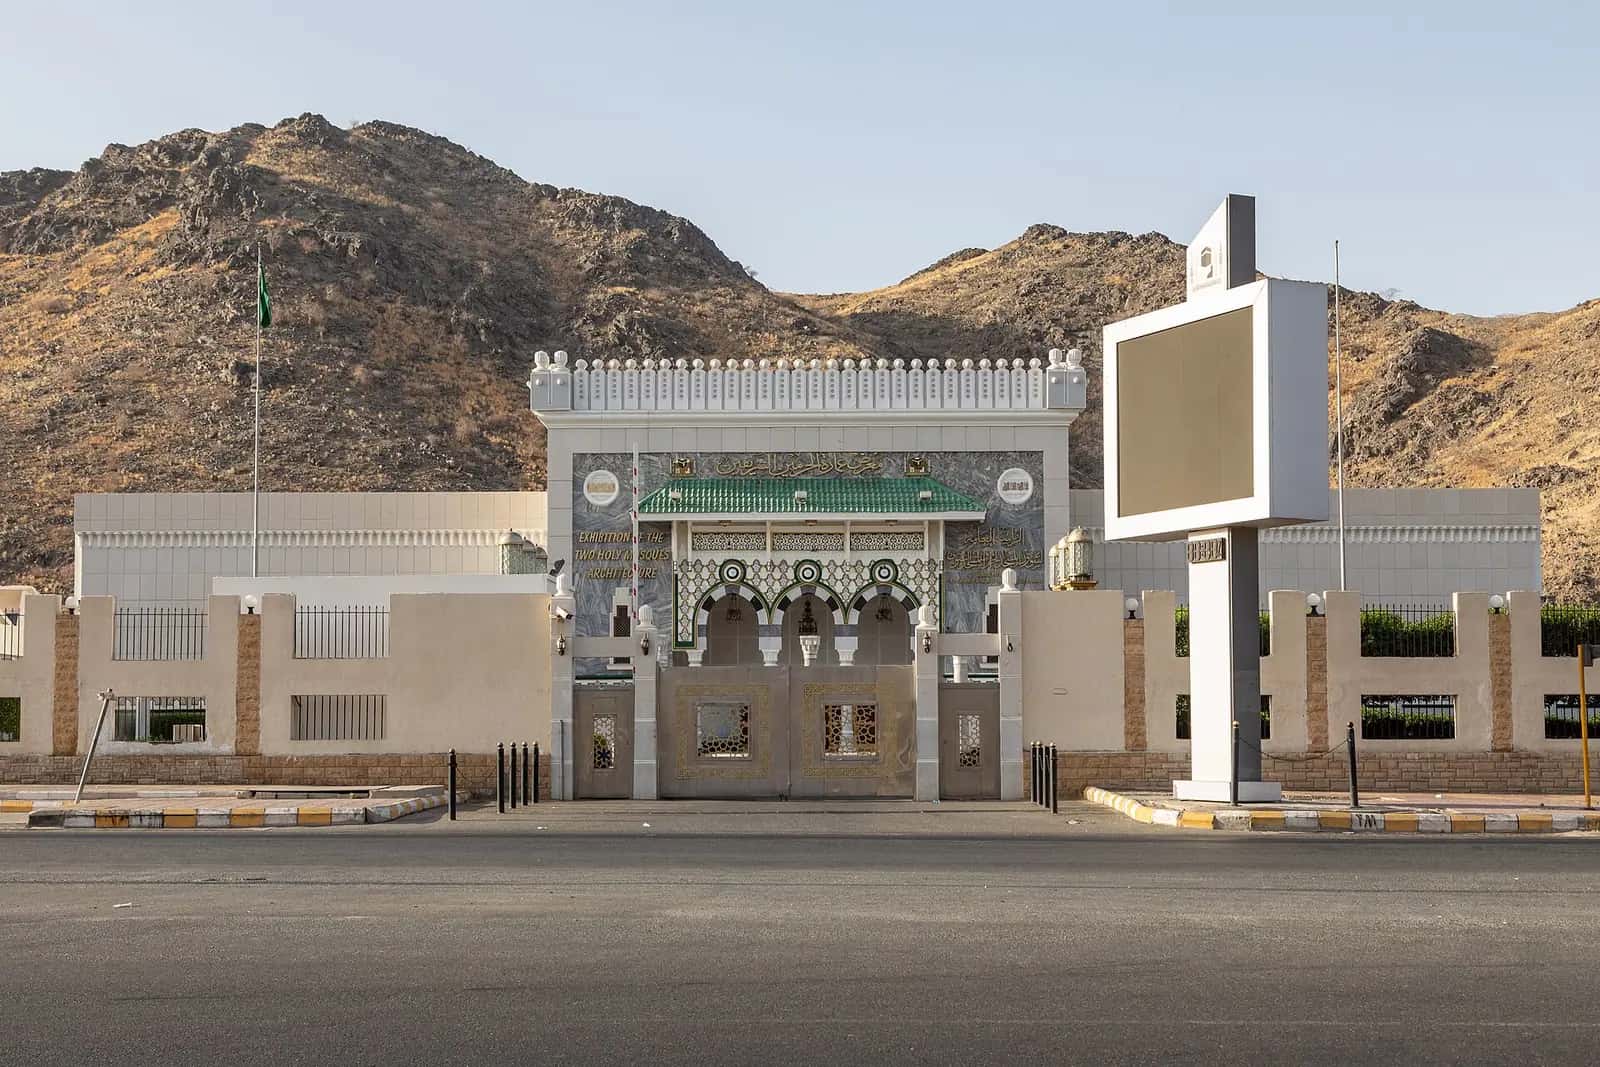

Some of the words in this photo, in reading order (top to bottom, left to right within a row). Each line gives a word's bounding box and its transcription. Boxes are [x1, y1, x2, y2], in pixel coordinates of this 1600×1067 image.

[579, 530, 631, 543] EXHIBITION
[647, 531, 665, 543] THE
[575, 549, 596, 561] TWO
[597, 549, 622, 561] HOLY
[623, 549, 669, 561] MSQUES
[587, 567, 657, 579] ARCHITECURE
